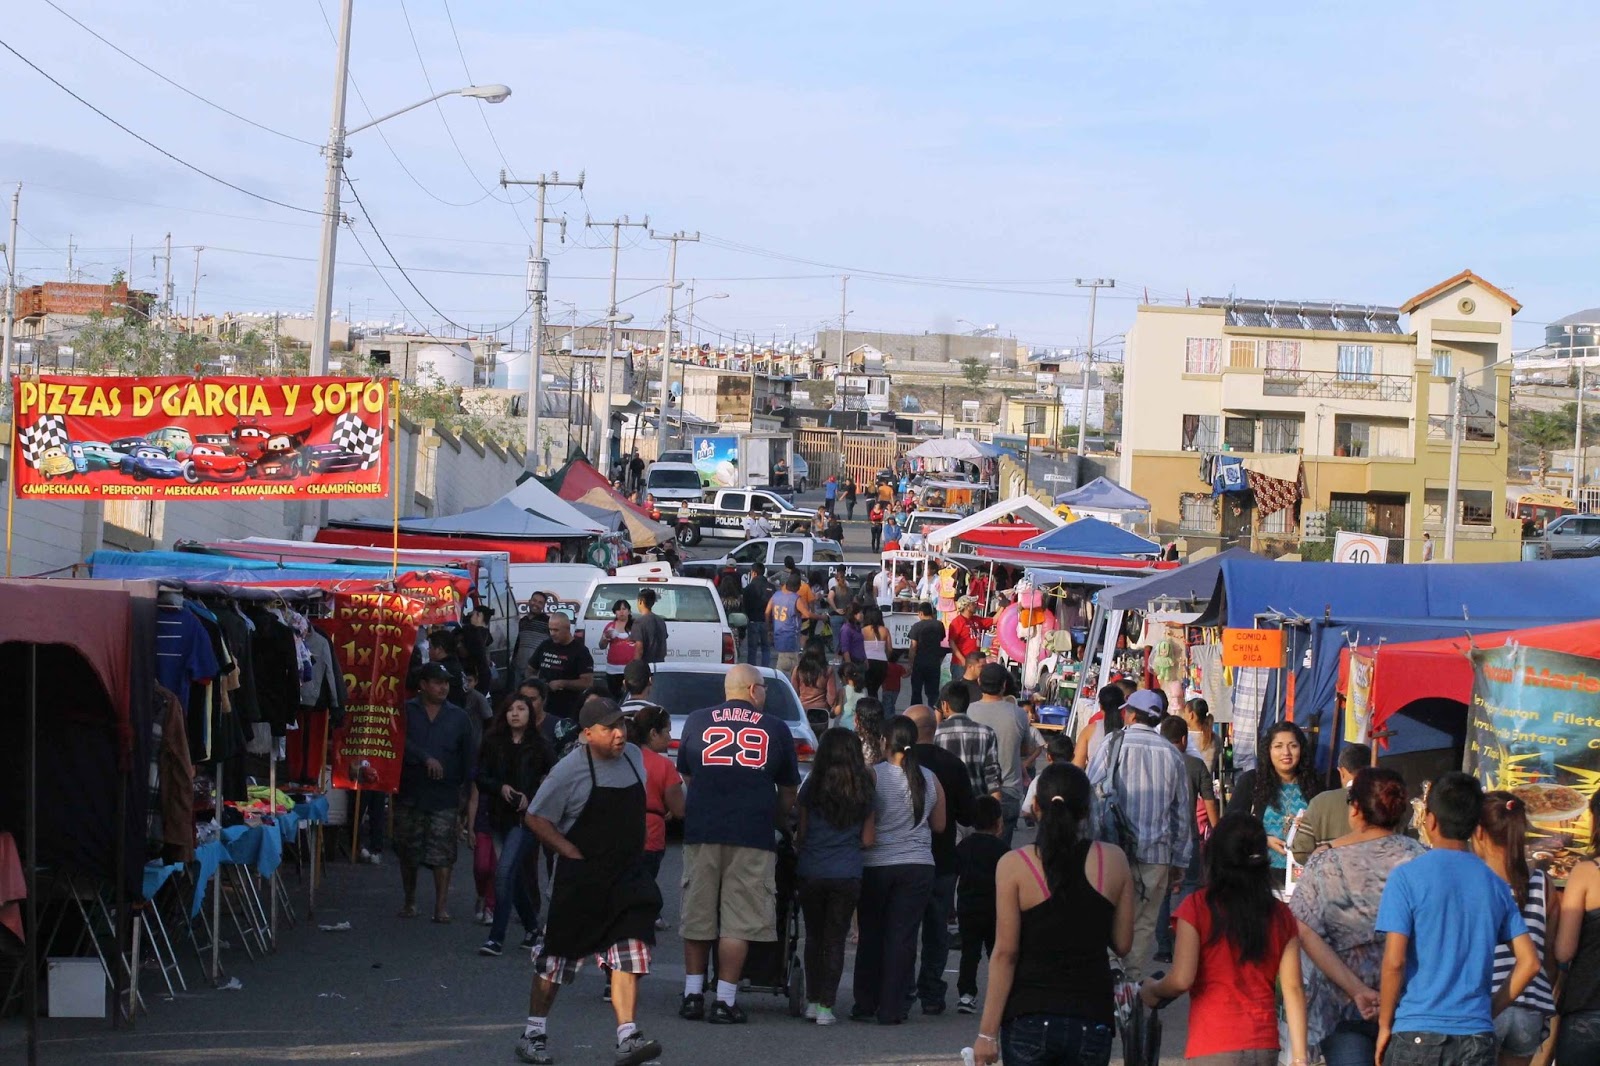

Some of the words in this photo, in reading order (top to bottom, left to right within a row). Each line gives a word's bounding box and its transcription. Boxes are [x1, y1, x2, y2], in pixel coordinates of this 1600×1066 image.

[20, 382, 122, 417] PIZZAS
[132, 384, 272, 417] D'GARCIA
[280, 384, 299, 417] Y
[312, 381, 385, 416] SOTO
[22, 484, 91, 495] CAMPECHANA
[101, 484, 153, 496] PEPERONI
[164, 485, 220, 496] MEXICANA
[306, 481, 382, 494] CHAMPIÑONES
[1349, 549, 1370, 563] 40
[518, 600, 577, 614] Cteña
[350, 623, 362, 635] Y
[368, 623, 402, 638] SOTO
[1236, 632, 1267, 640] COMIDA
[1232, 643, 1260, 652] CHINA
[1242, 654, 1262, 662] RICA
[711, 707, 763, 724] CAREW
[702, 726, 769, 768] 29
